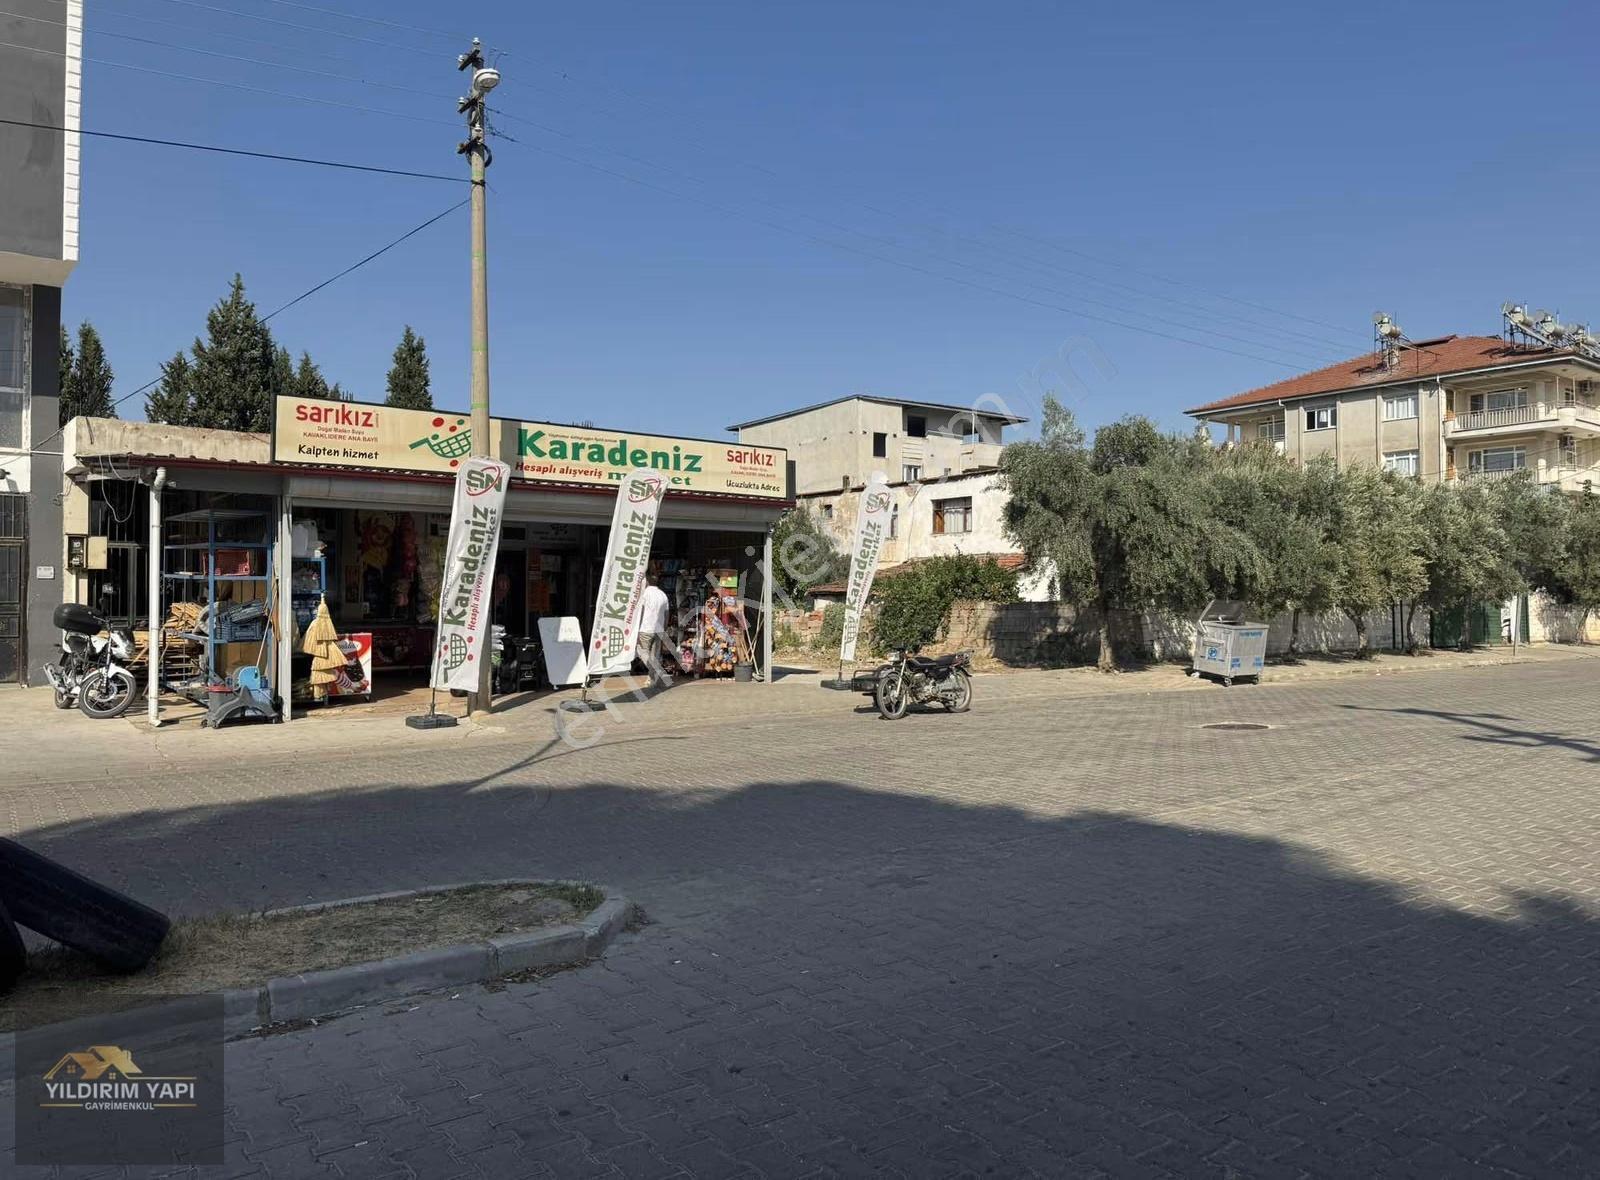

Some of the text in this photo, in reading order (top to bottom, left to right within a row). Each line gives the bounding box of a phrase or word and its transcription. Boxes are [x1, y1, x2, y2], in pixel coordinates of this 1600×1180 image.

[295, 403, 374, 428] sarıkız
[298, 443, 380, 460] Kalpten hizmet
[517, 428, 703, 474] Karadeniz
[727, 448, 773, 467] sarıkız
[515, 461, 603, 479] Hesaplı alışveriş
[443, 505, 489, 627] Karadeniz
[603, 510, 647, 622] Karadeniz
[846, 520, 877, 611] Karadeniz
